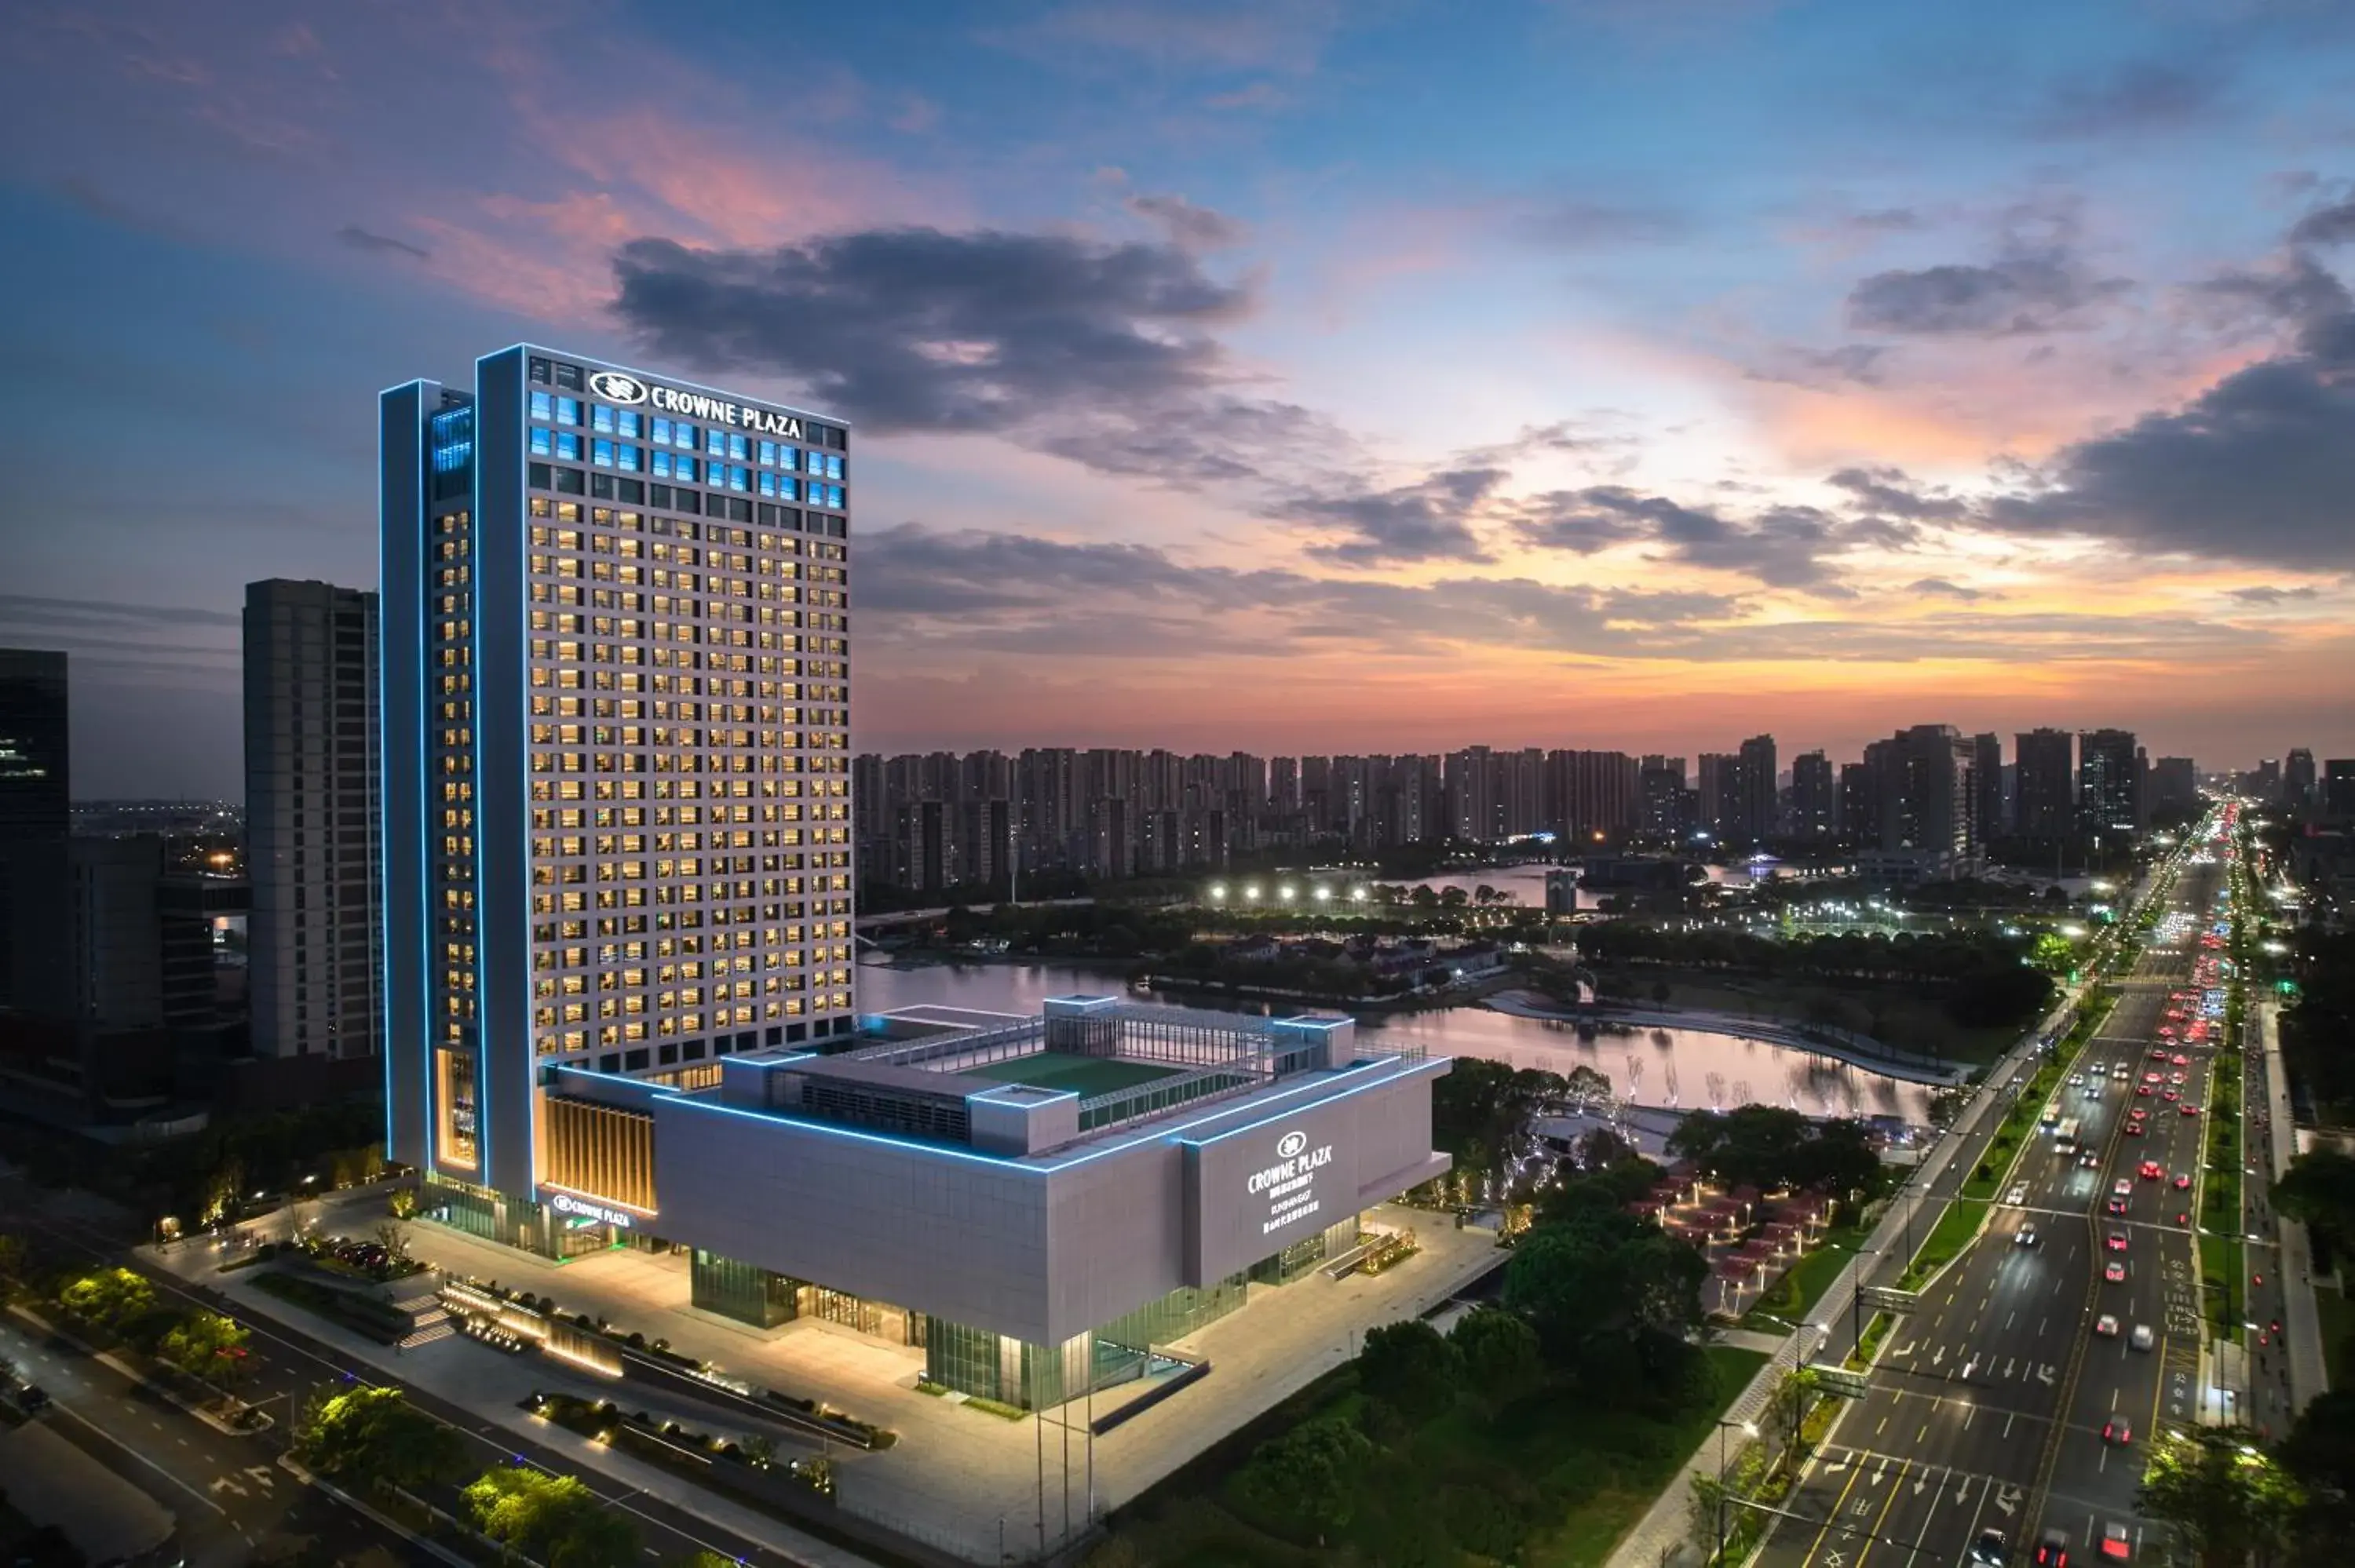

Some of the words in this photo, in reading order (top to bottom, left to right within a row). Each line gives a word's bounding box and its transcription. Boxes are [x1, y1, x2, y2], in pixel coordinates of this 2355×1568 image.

[650, 386, 736, 425] CROWNE
[742, 407, 801, 439] PLAZA
[1247, 1159, 1296, 1194] CROWNE
[1298, 1145, 1332, 1173] PLAZA
[571, 1200, 603, 1220] CROWNE
[604, 1209, 630, 1227] PLAZA
